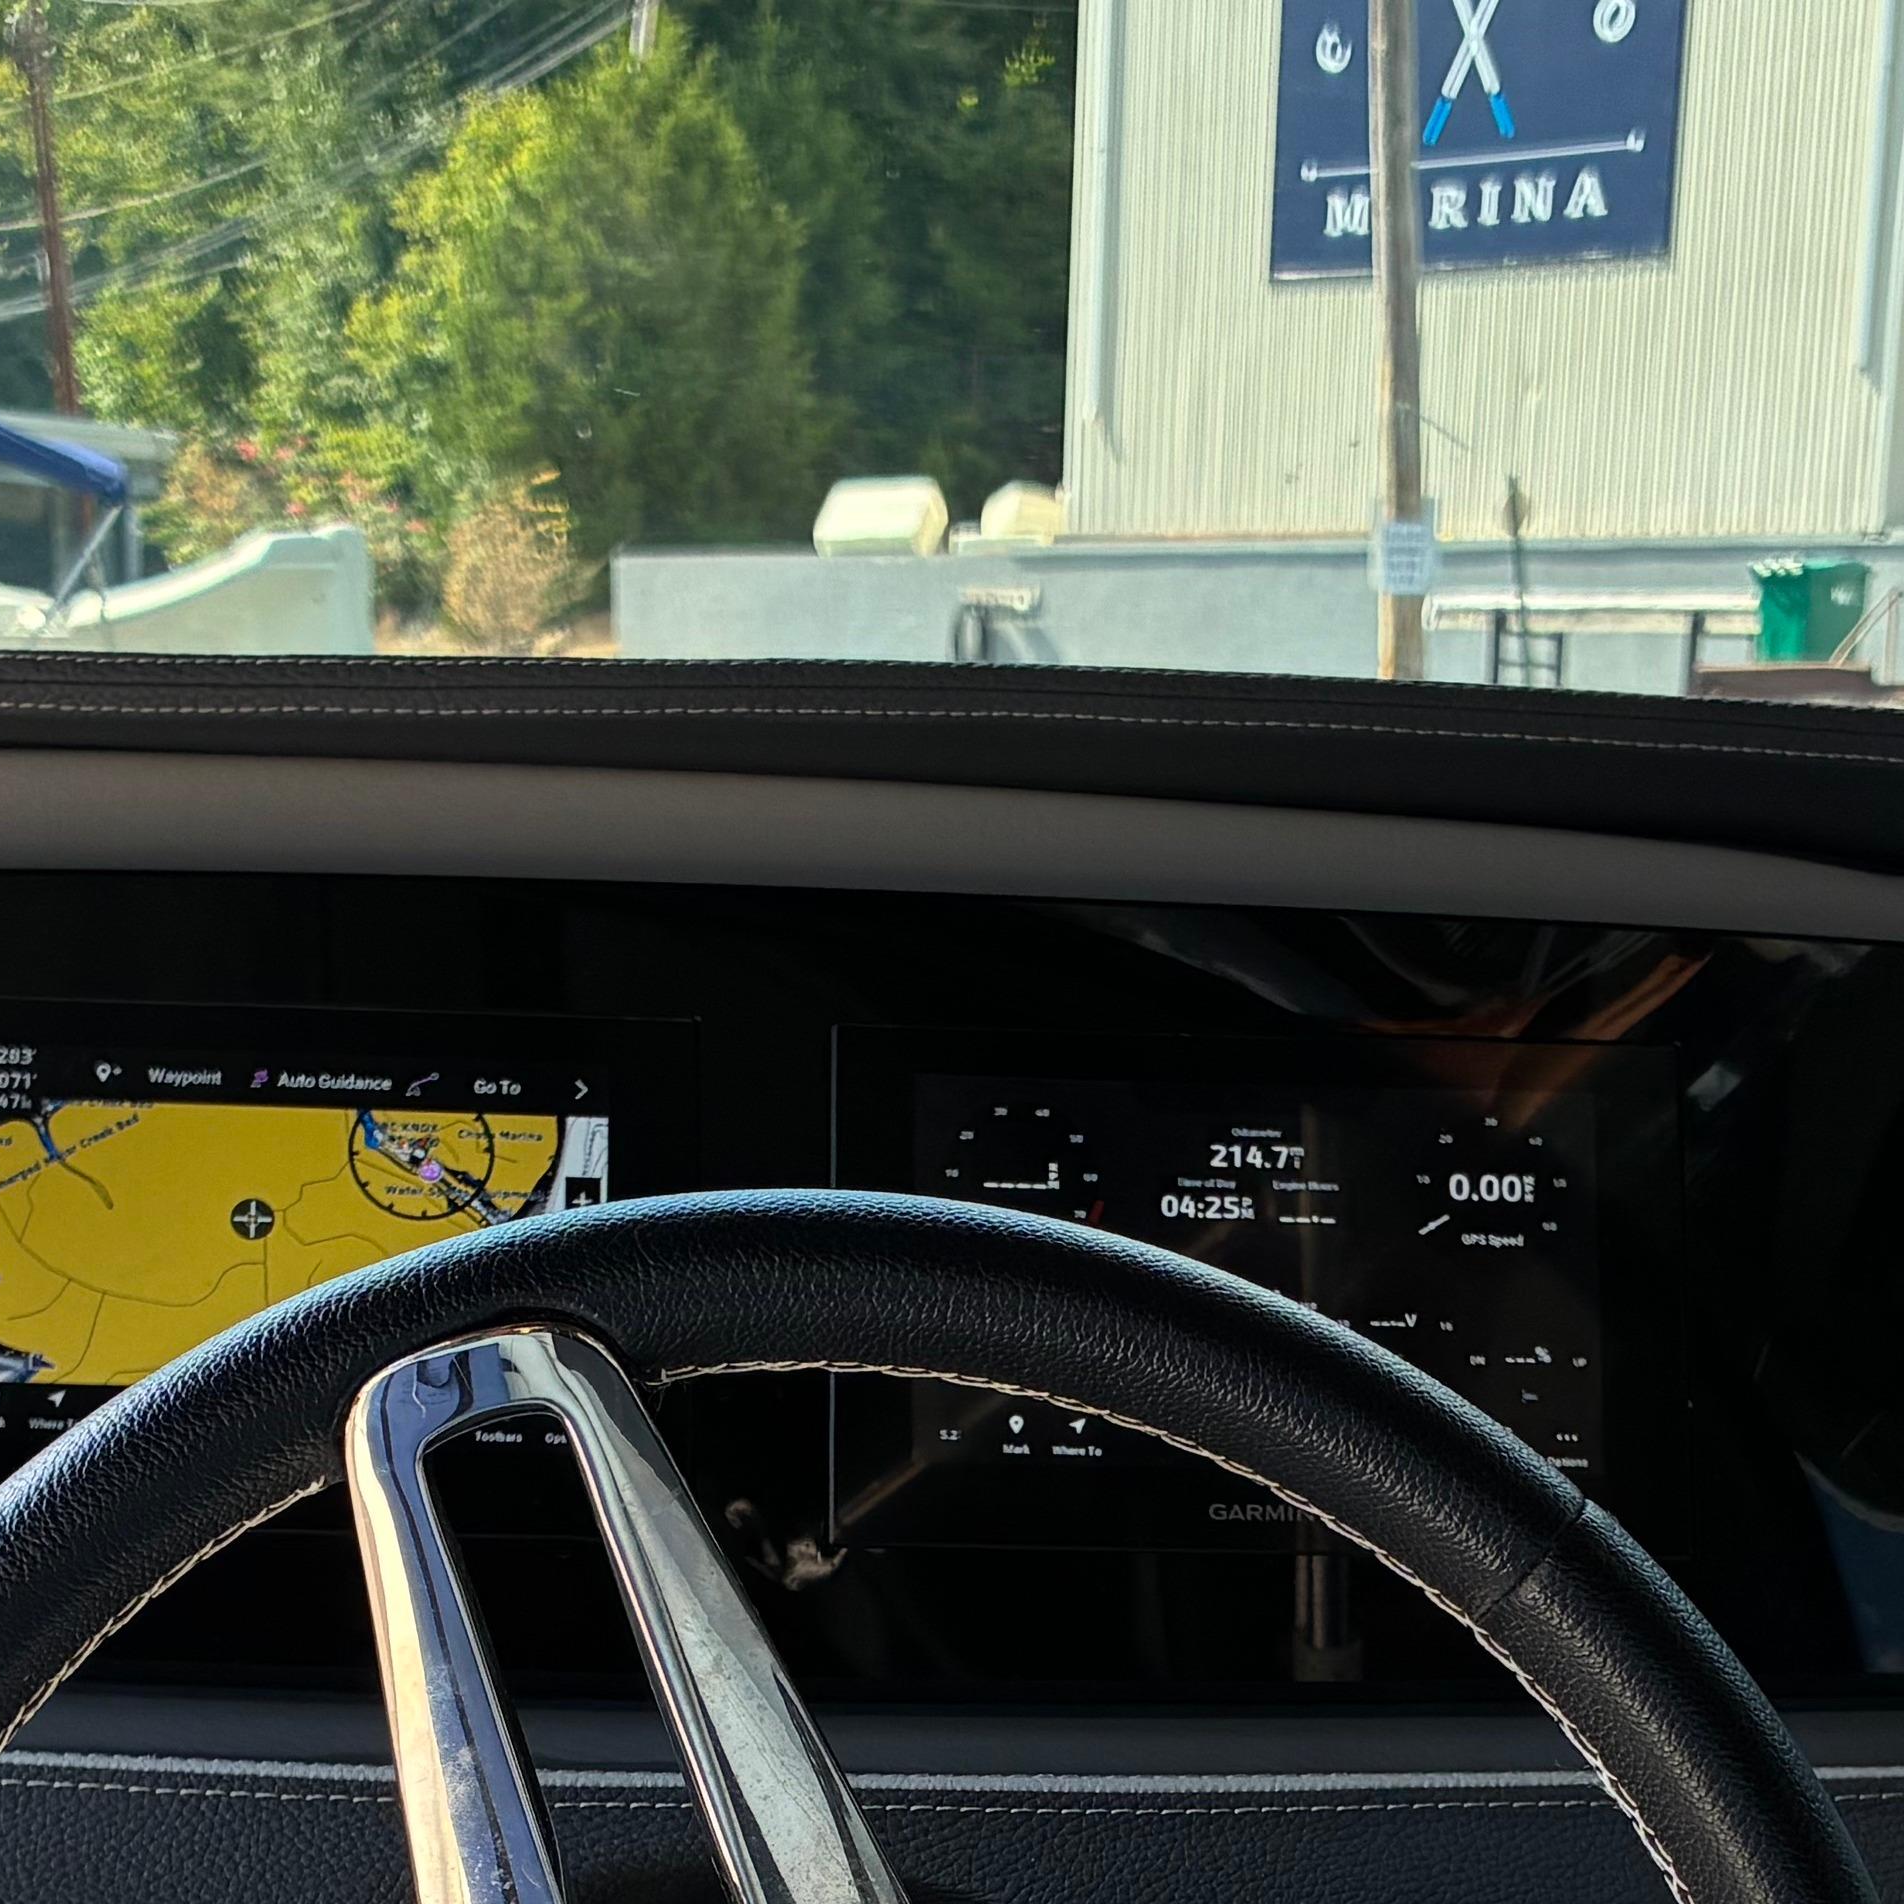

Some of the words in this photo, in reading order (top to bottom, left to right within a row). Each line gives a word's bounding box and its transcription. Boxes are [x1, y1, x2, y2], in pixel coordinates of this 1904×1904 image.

[1323, 165, 1608, 237] MRINA
[148, 1067, 222, 1087] Waypoint
[278, 1073, 315, 1089] Auto
[318, 1074, 392, 1091] Guidance
[474, 1079, 496, 1094] Go
[499, 1079, 521, 1095] To
[1209, 1144, 1288, 1169] 214.7
[1449, 1173, 1522, 1202] 0.00
[1161, 1195, 1241, 1219] 04:25
[1003, 1444, 1030, 1455] Mark
[1053, 1445, 1083, 1456] Where
[1084, 1445, 1102, 1457] To
